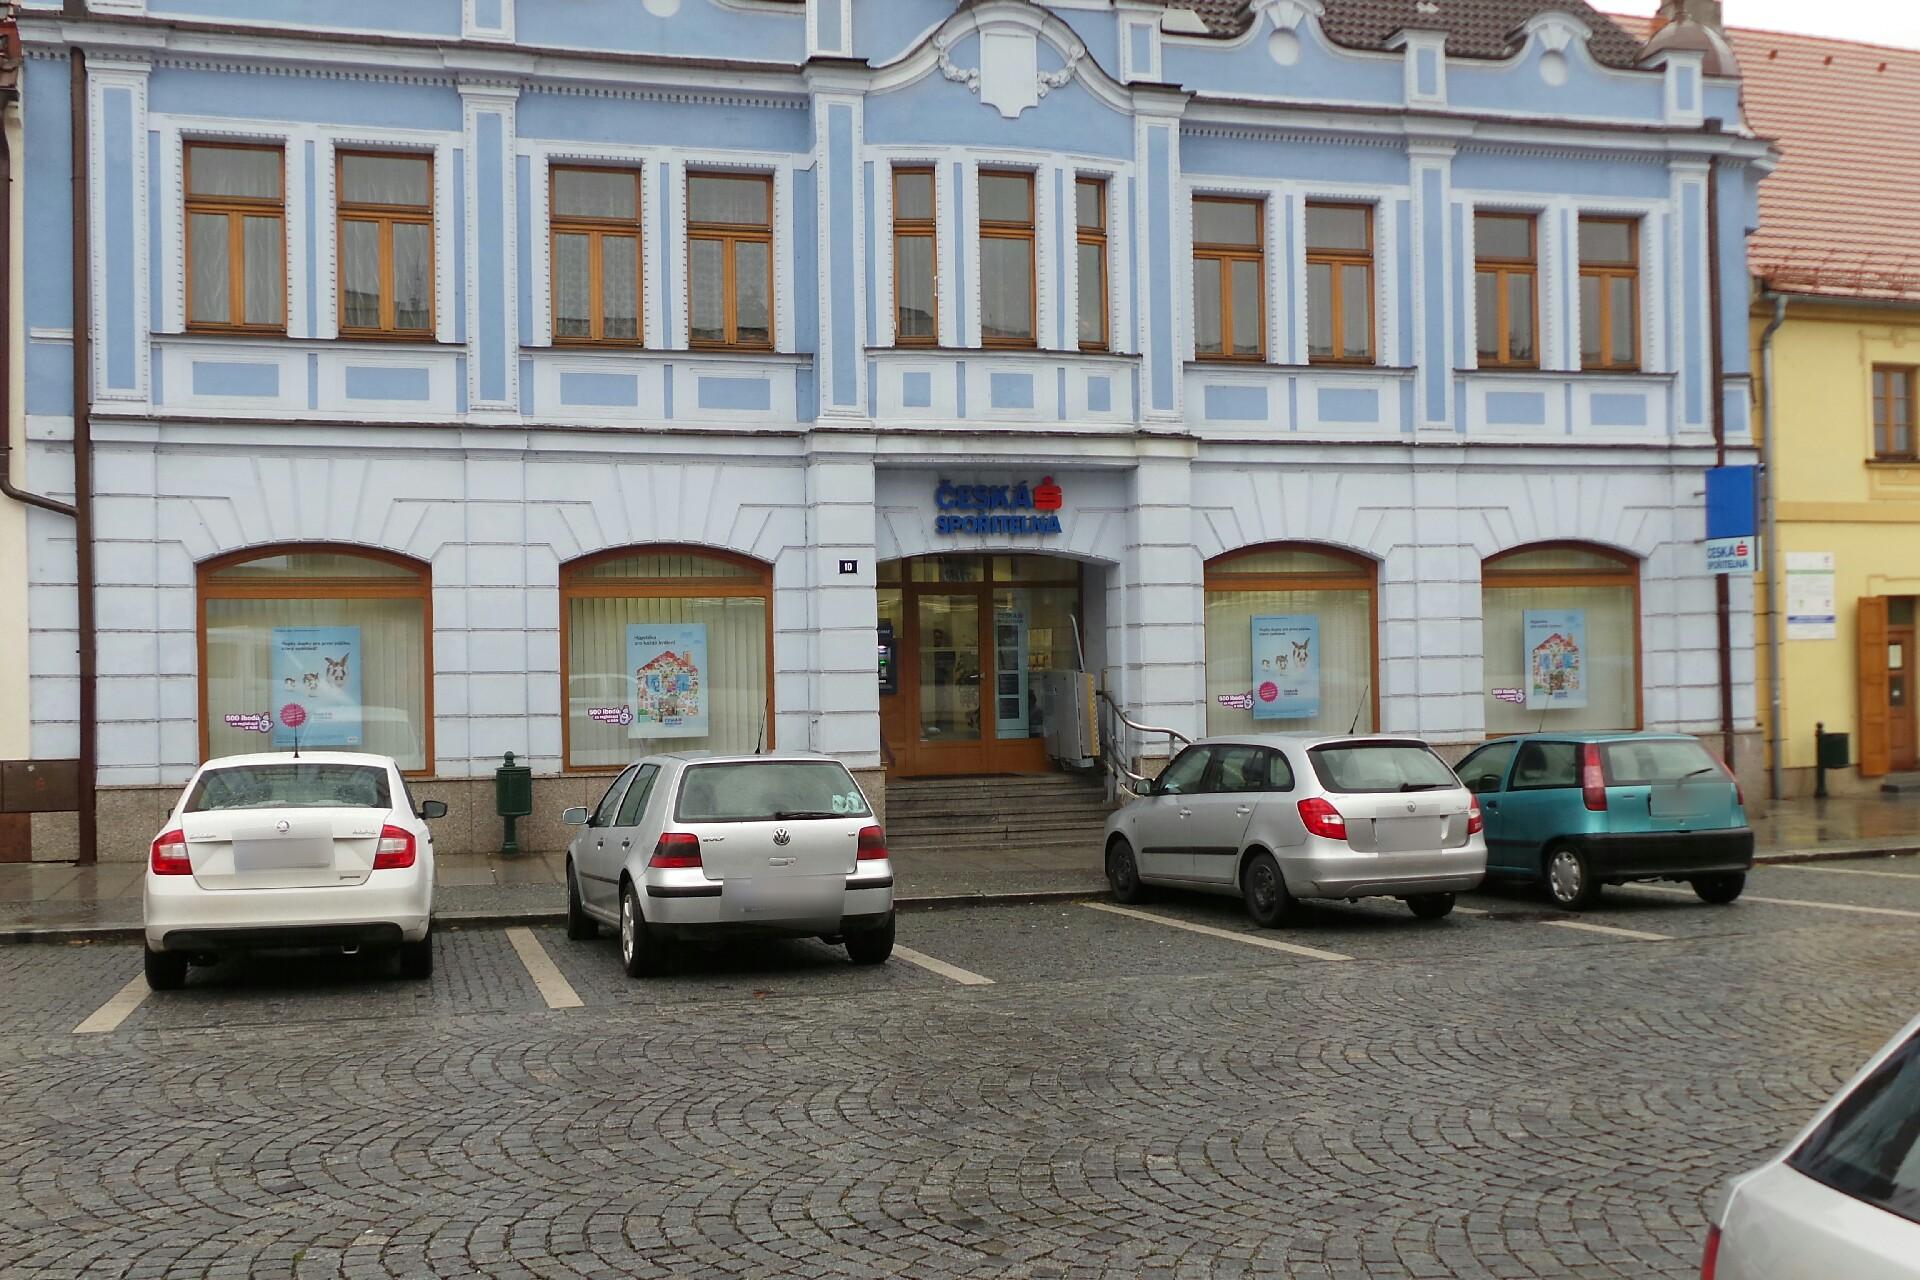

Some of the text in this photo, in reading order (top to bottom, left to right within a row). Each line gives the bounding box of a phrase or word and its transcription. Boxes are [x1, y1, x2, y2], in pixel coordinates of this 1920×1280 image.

[935, 479, 1033, 510] ČESKÁ
[935, 510, 1062, 535] SPOŘITELNA
[844, 562, 853, 571] 10
